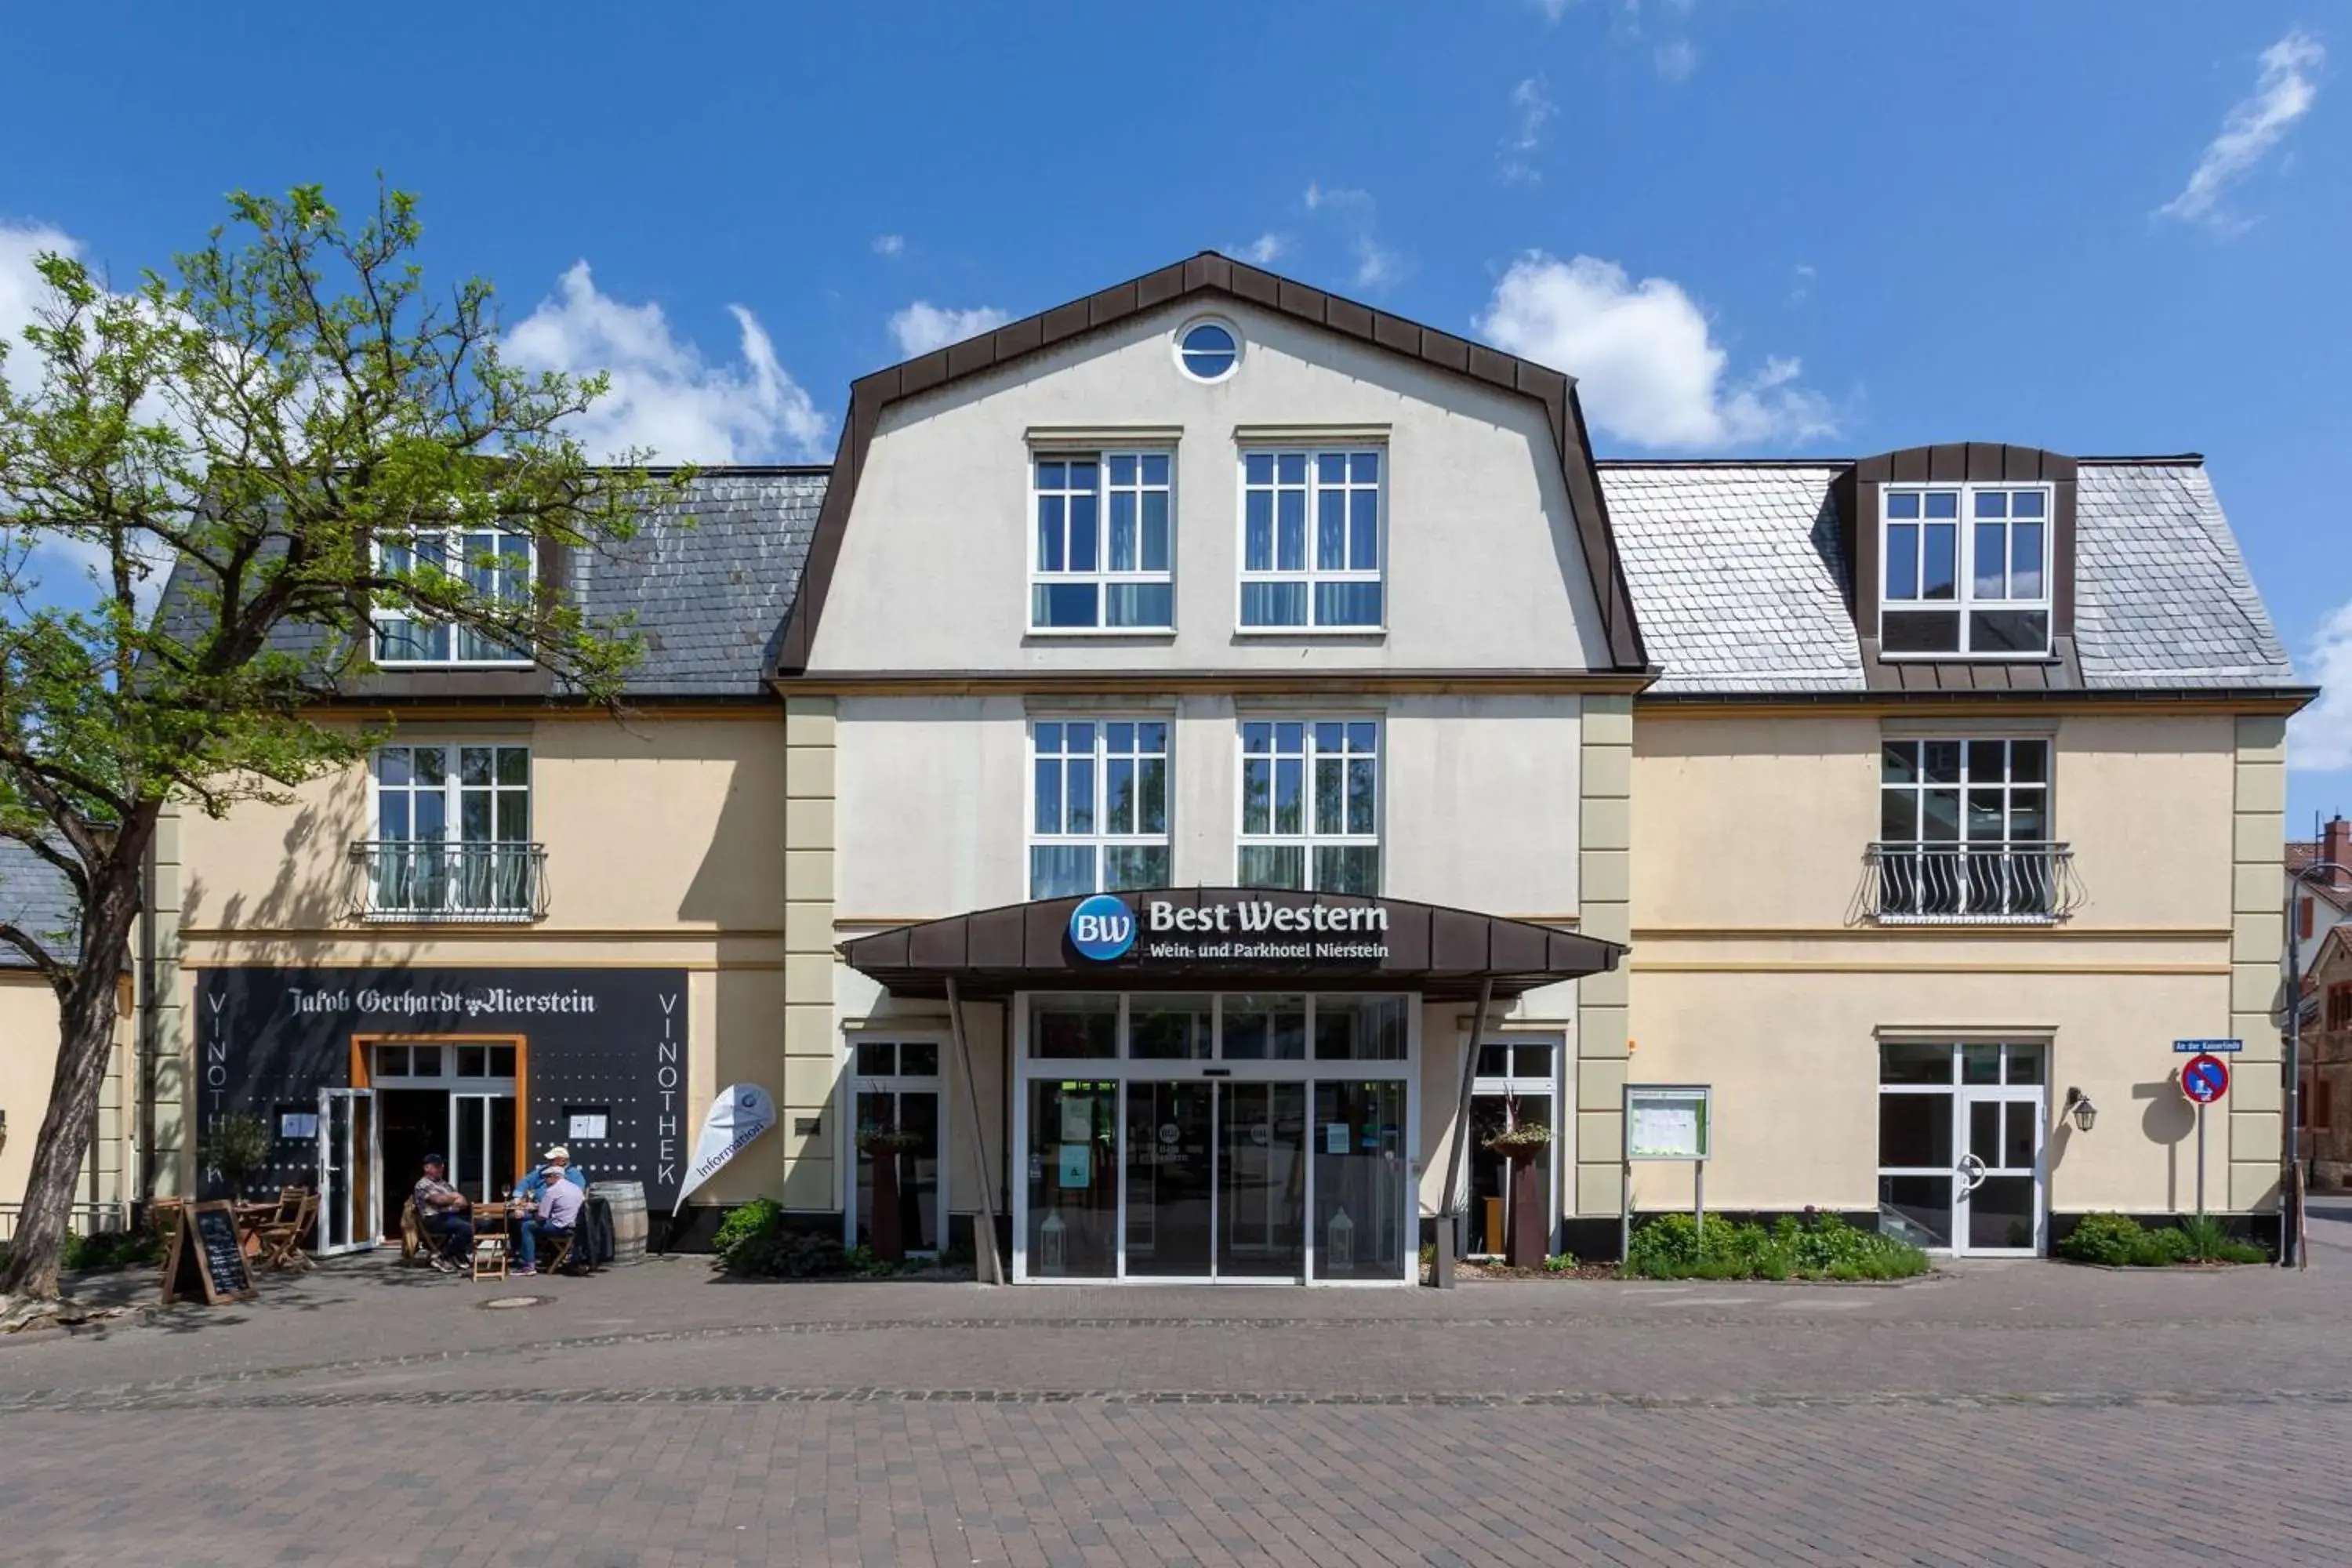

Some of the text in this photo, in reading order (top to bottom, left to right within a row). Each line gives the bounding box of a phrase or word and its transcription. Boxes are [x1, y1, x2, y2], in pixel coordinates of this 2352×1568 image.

[1077, 914, 1130, 943] BW
[1150, 901, 1389, 931] Best Western
[1150, 942, 1389, 957] Wein- und Parkhotel Nierstein
[288, 988, 596, 1017] Jakob Gerhardt Nierstein
[658, 993, 677, 1185] VINOTHEK
[696, 1121, 765, 1178] Information
